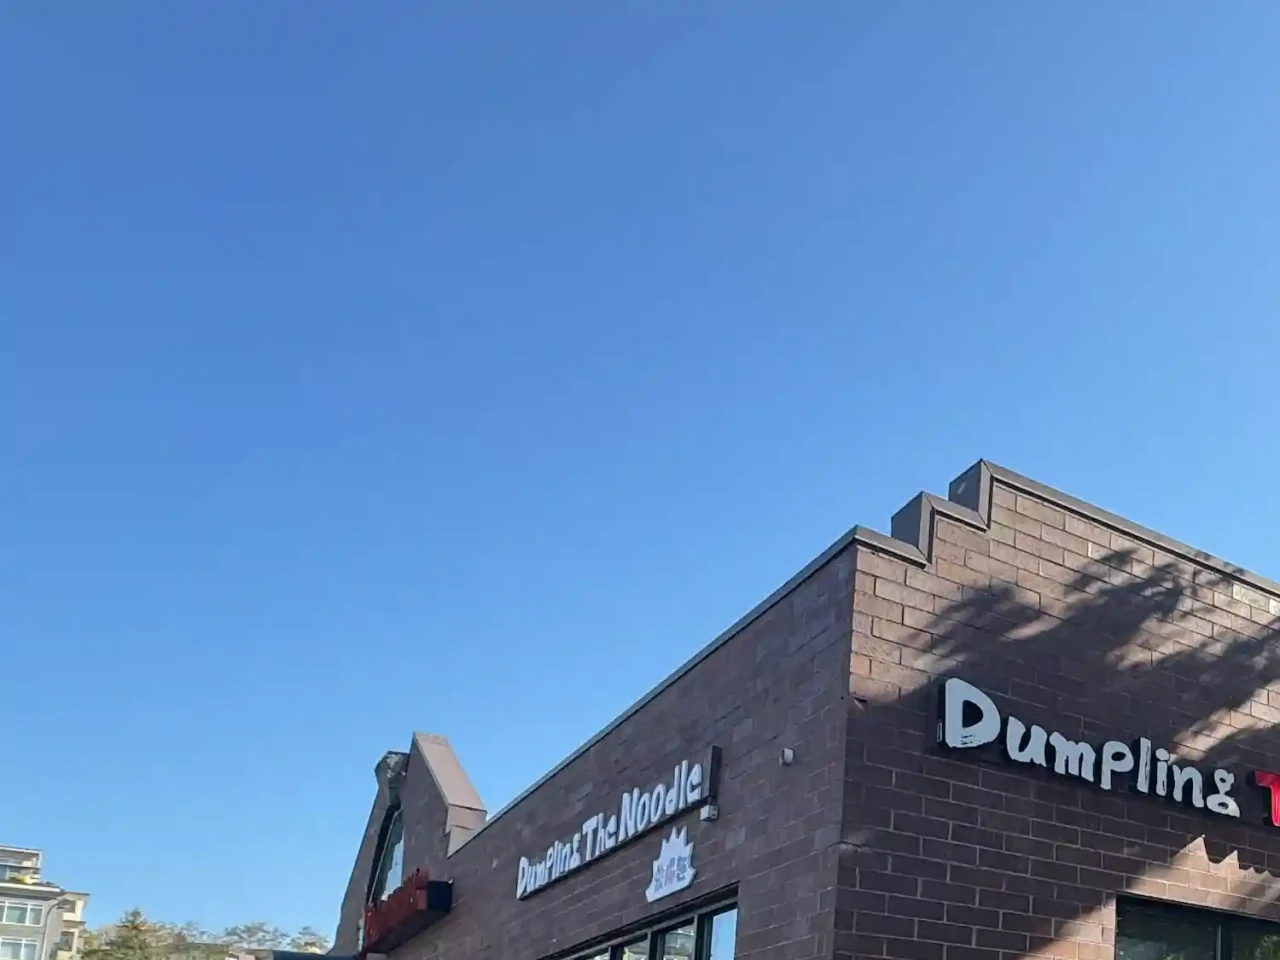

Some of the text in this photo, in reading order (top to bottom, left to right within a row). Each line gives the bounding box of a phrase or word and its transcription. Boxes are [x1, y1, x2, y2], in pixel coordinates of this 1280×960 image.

[944, 677, 1241, 818] Dumpling
[516, 832, 581, 900] Dumpling
[582, 812, 617, 861] The
[618, 760, 703, 843] Noodle
